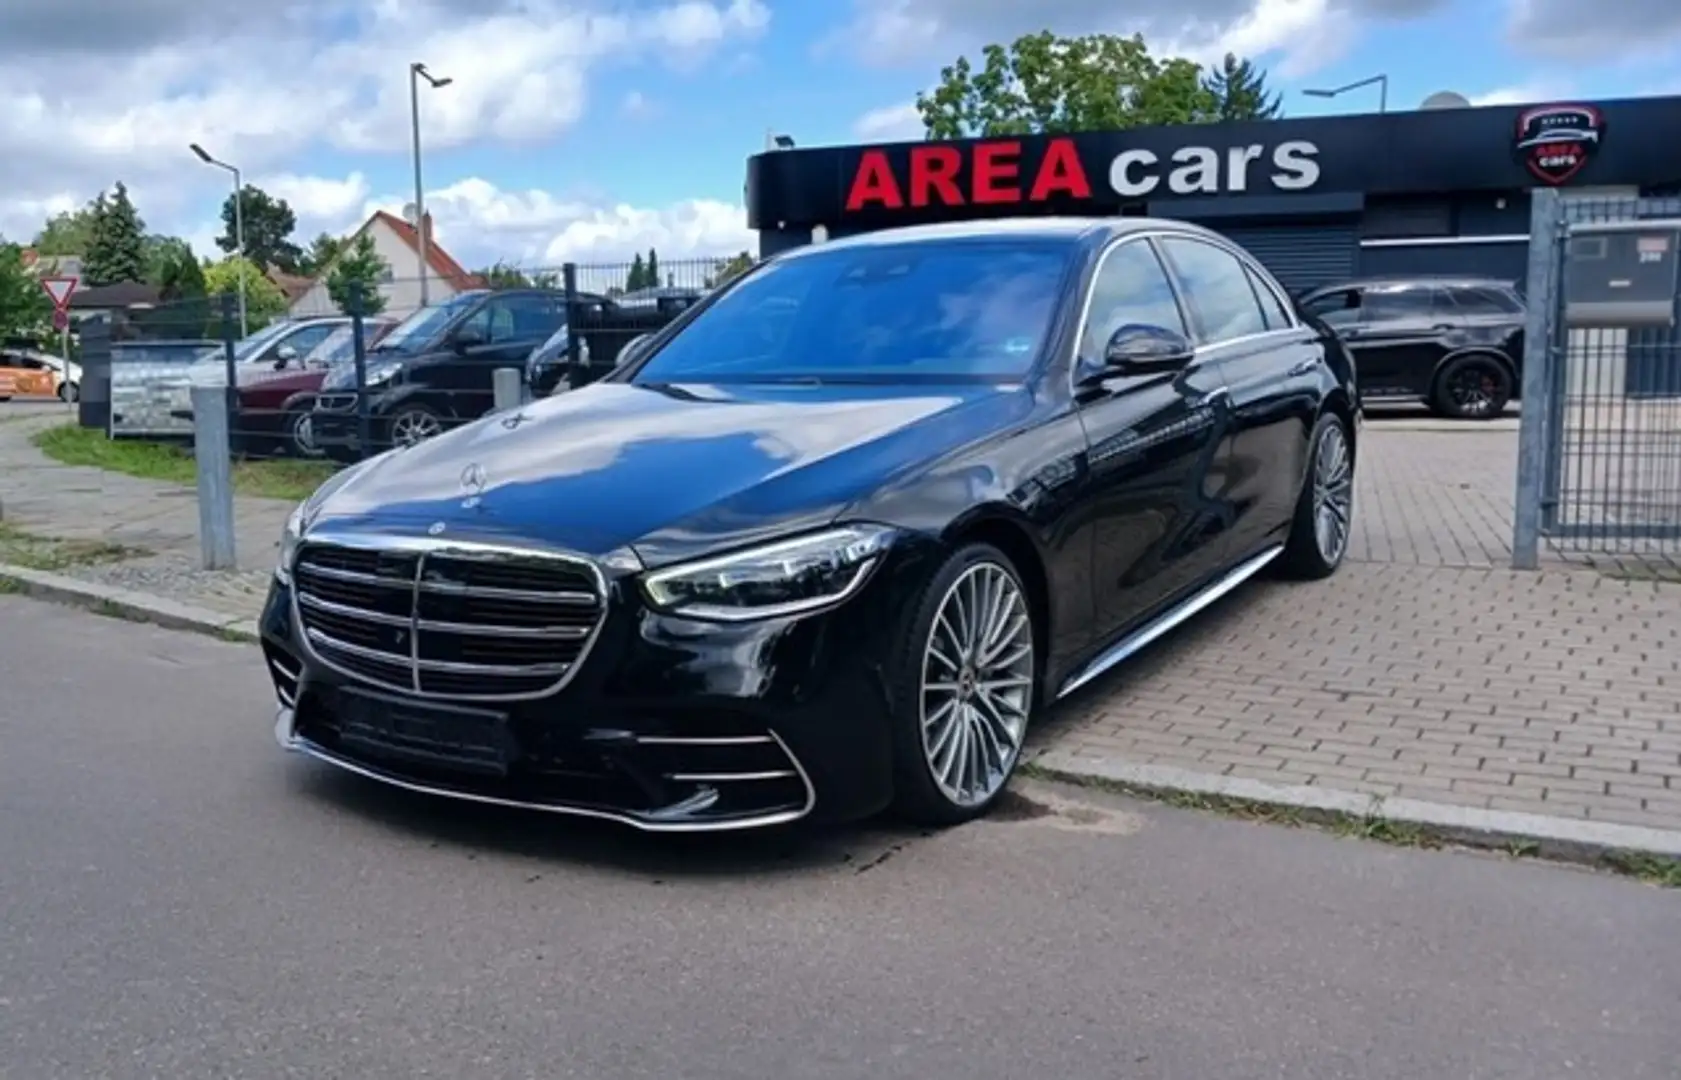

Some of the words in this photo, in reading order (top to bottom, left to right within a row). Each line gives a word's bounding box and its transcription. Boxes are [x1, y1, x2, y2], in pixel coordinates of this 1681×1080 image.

[845, 138, 1092, 210] AREA
[1108, 140, 1320, 196] cars
[1539, 154, 1577, 167] cars
